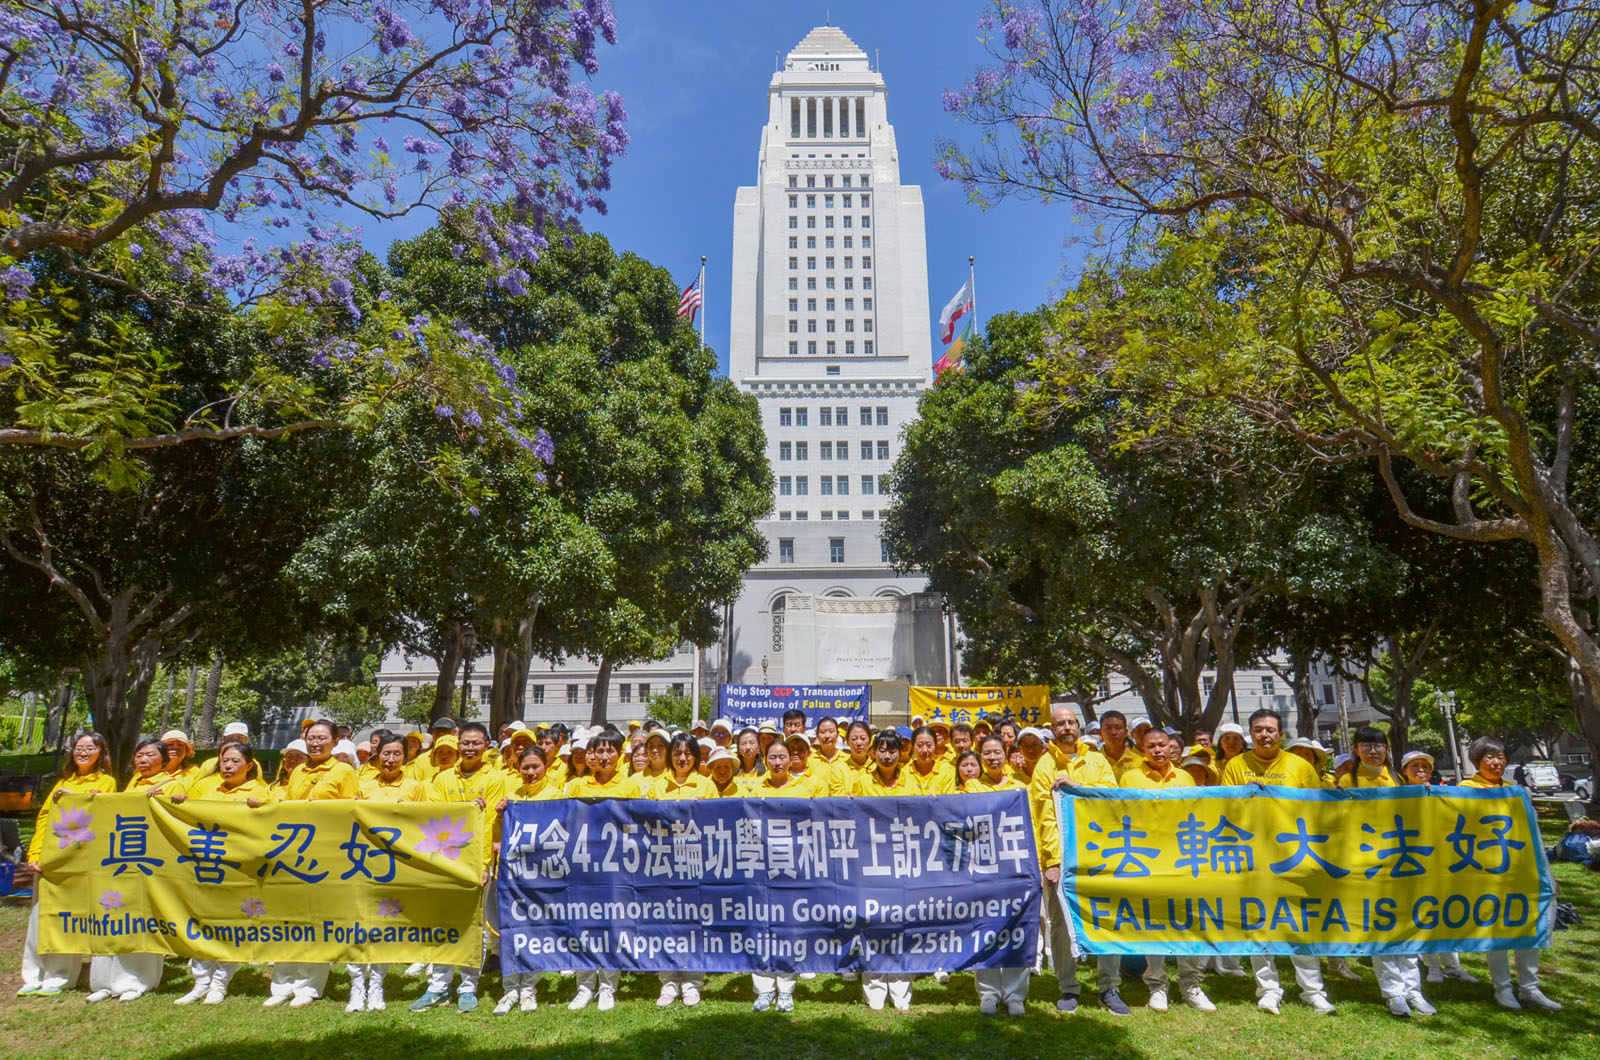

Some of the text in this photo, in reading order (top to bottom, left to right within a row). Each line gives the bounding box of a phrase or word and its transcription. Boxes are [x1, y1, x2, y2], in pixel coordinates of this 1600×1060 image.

[727, 685, 865, 698] Help Stop CCP's Transnational
[727, 698, 860, 710] Repression of Falun Gong
[937, 689, 1023, 700] FALUN DAFA
[1085, 812, 1525, 880] 法輪大法好
[510, 896, 714, 925] Commemorating
[720, 896, 784, 922] Falun
[792, 898, 857, 928] Gong
[1090, 893, 1529, 933] FALUN DAFA IS GOOD
[58, 911, 459, 947] Truthfulness Compassion Forbearance
[513, 927, 1026, 962] Peaceful Appeal in Beijing on April 25th 1999
